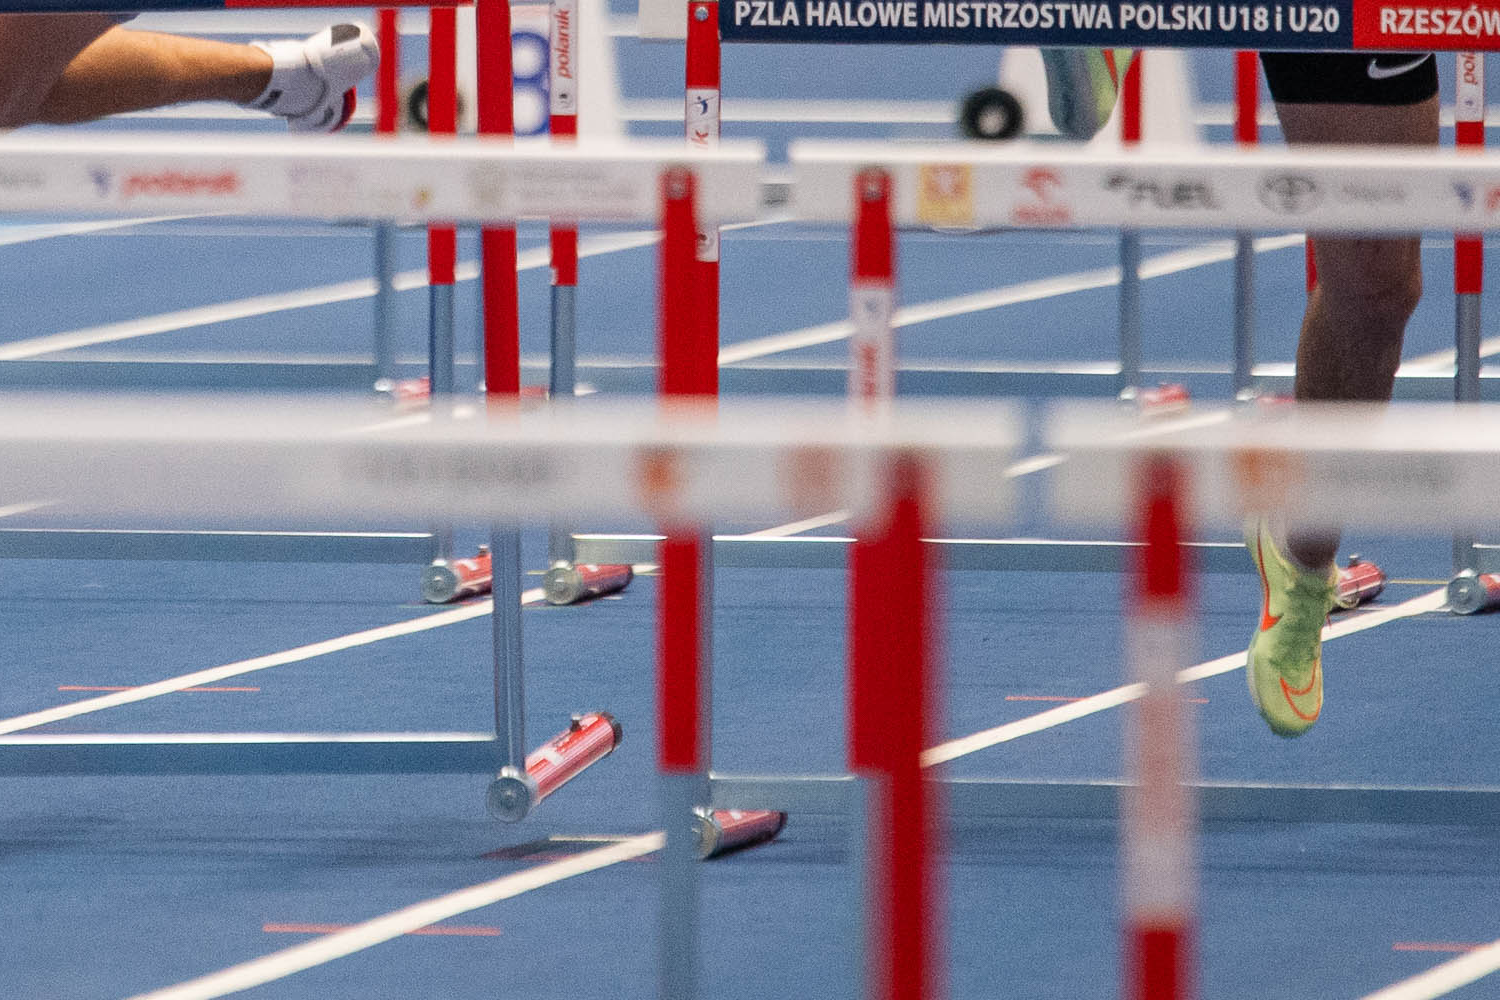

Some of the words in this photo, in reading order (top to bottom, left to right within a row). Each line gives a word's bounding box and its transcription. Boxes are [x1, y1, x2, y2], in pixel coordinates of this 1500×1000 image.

[554, 7, 571, 79] polanik
[734, 1, 800, 27] PZLA
[805, 1, 917, 28] HALOWE
[923, 2, 1114, 30] MISTRZOSTWA
[1119, 4, 1212, 31] POLSKI
[1217, 5, 1269, 32] U18
[1275, 6, 1282, 32] i
[1288, 7, 1341, 33] U20
